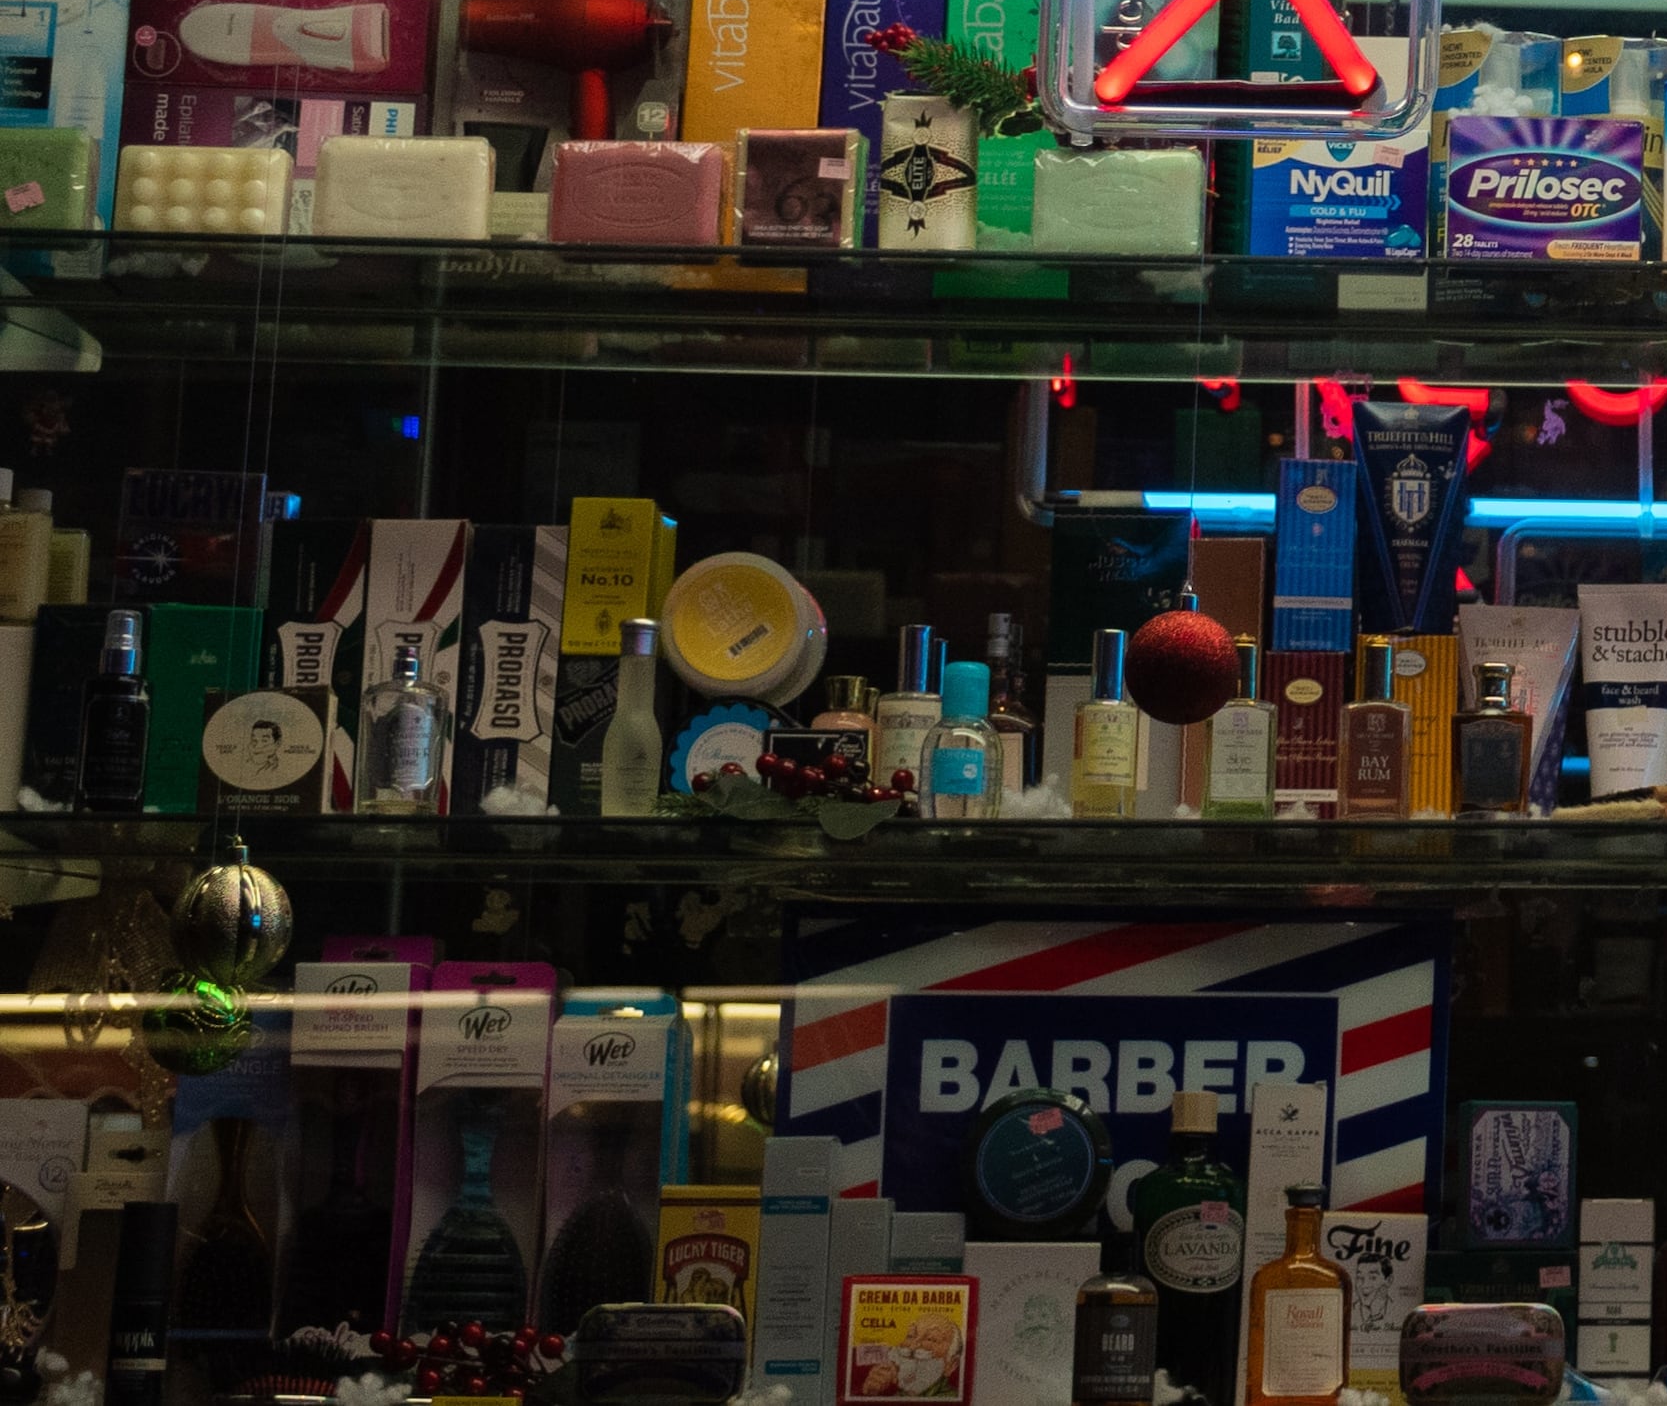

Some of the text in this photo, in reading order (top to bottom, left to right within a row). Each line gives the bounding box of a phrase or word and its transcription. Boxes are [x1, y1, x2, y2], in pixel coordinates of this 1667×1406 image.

[154, 94, 169, 141] made
[639, 108, 668, 123] 12
[911, 156, 926, 191] ELITE
[1290, 169, 1392, 203] NyQuil
[1467, 169, 1627, 201] Prilosec
[1310, 207, 1337, 216] COLD
[1348, 207, 1367, 217] FLU
[1570, 203, 1600, 218] OTC
[1452, 234, 1474, 247] 28
[580, 571, 634, 589] No.10
[1592, 645, 1608, 662] &
[491, 635, 519, 729] PRORASO
[1600, 684, 1621, 695] face
[1634, 683, 1660, 695] beard
[1618, 695, 1643, 705] wash
[1360, 754, 1389, 769] BAY
[1357, 768, 1391, 781] RUM
[459, 1010, 510, 1035] Wet
[587, 1035, 637, 1063] Wet
[919, 1038, 1307, 1115] BARBER
[667, 1233, 747, 1263] LUCKY TIGER
[1163, 1241, 1239, 1259] LAVANDA
[1326, 1221, 1413, 1264] Fine
[858, 1289, 962, 1306] CREMA DA BARBA
[860, 1317, 897, 1330] CELLA
